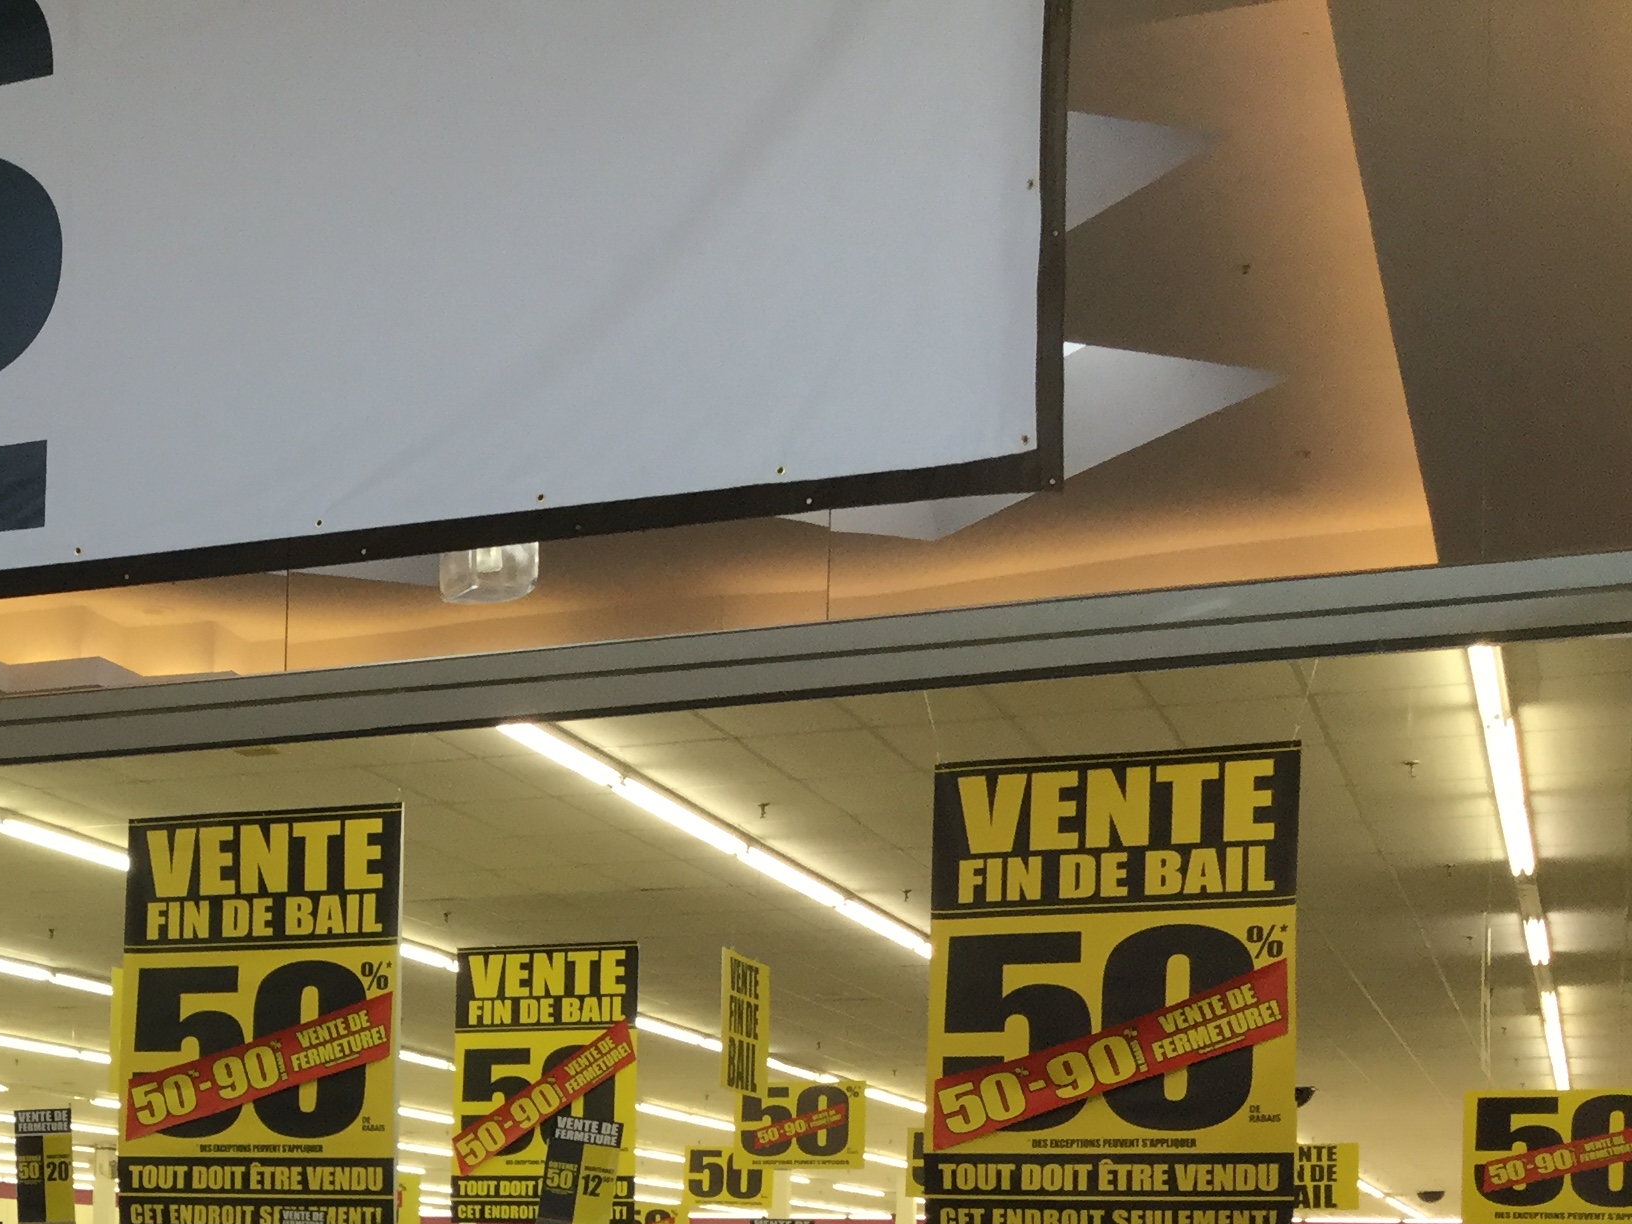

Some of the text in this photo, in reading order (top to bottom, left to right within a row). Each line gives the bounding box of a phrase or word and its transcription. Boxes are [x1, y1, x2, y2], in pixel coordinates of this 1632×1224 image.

[958, 759, 1275, 855] VENTE
[146, 818, 383, 898] VENTE
[958, 845, 1275, 904] FIN DE BAIL
[146, 893, 383, 940] FIN DE BAIL
[469, 949, 626, 998] VENTE
[729, 956, 759, 1001] VENTE
[468, 996, 626, 1025] FIN DE BAIL
[729, 994, 759, 1040] FIN DE
[1158, 983, 1257, 1033] VENTE DE
[290, 1025, 388, 1072] FERMETURE!
[296, 1009, 371, 1049] VENTE DE
[1152, 1000, 1282, 1062] FERMETURE!
[564, 1036, 616, 1076] VENTE DE
[727, 1036, 757, 1093] BAIL
[18, 1110, 68, 1122] VENTE DE
[18, 1122, 68, 1132] FERMETURE
[557, 1116, 619, 1136] VENTE DE
[555, 1129, 618, 1146] FERMETURE
[129, 1162, 383, 1191] TOUT DOIT ÊTRE VENDU
[458, 1180, 534, 1196] TOUT DOIT
[938, 1159, 1279, 1192] TOUT DOIT ÊTRE VENDU
[1311, 1164, 1337, 1182] DE
[130, 1204, 164, 1224] CET
[458, 1205, 539, 1220] CET ENDROIT
[1294, 1184, 1337, 1209] AIL
